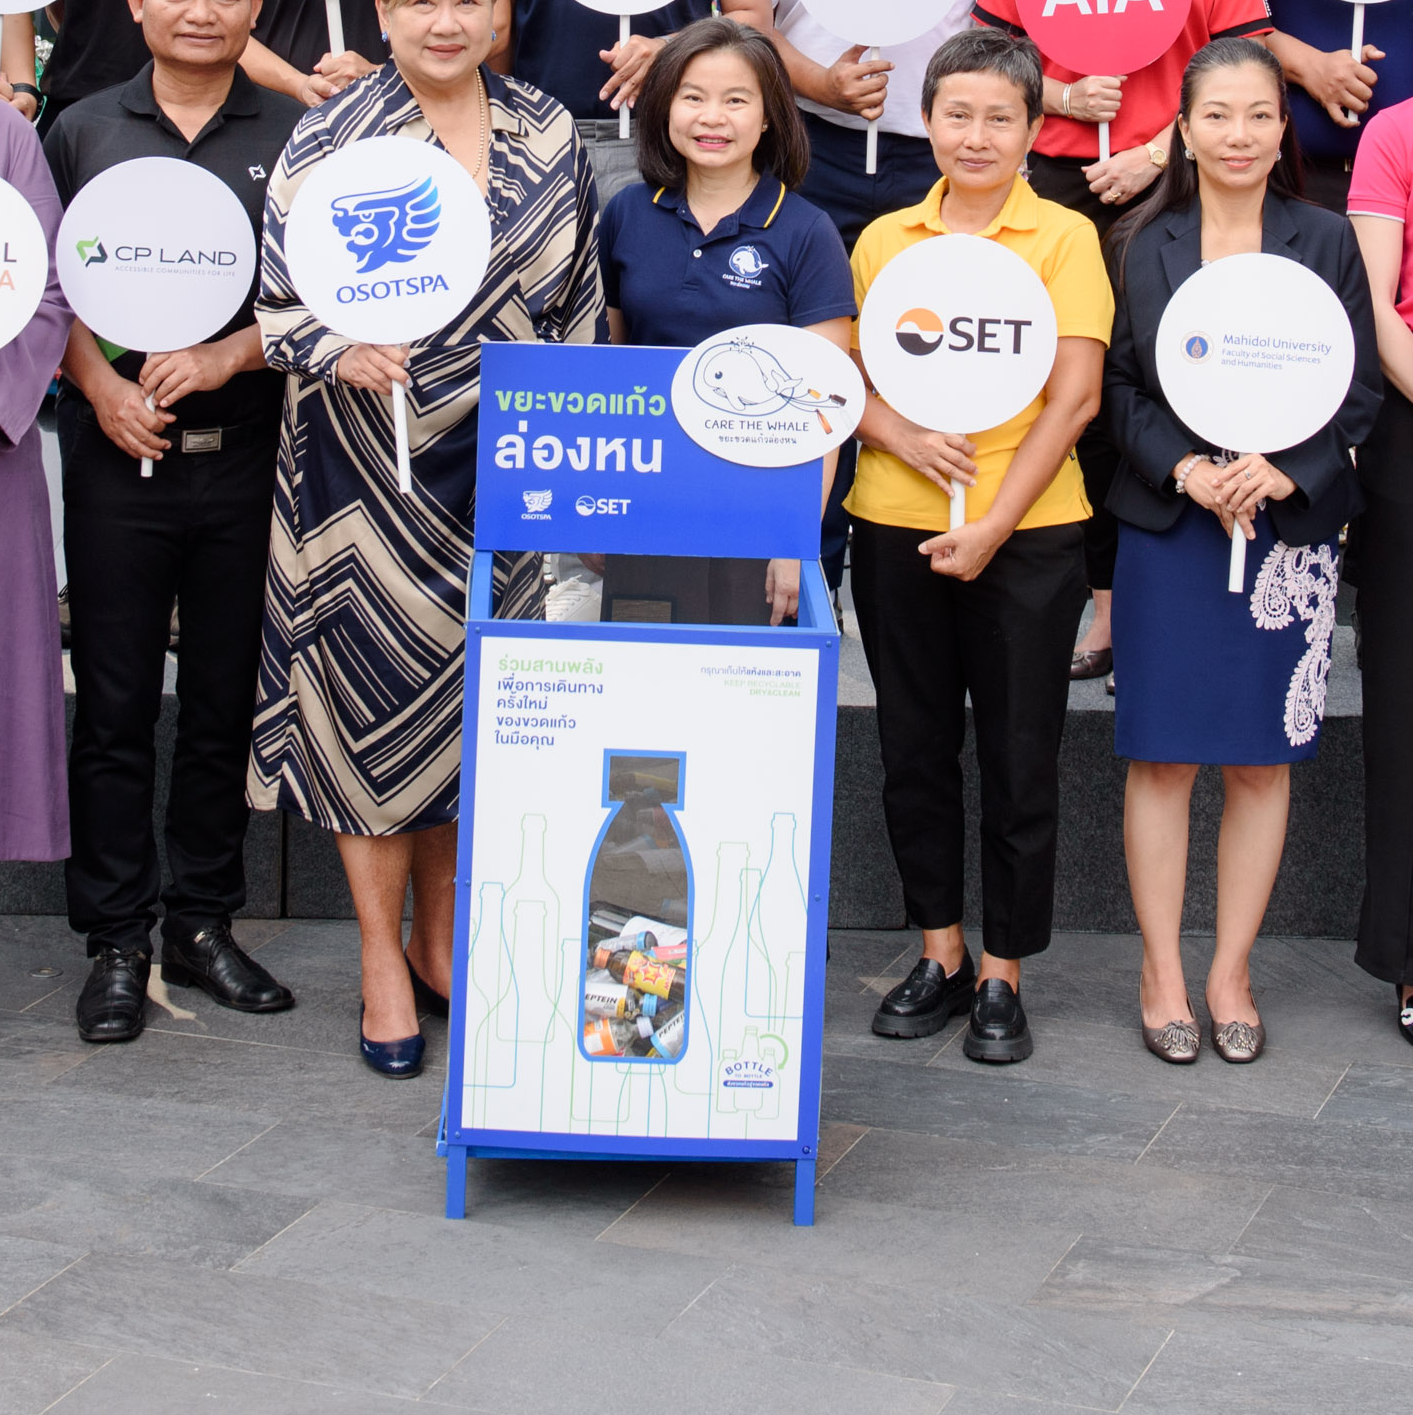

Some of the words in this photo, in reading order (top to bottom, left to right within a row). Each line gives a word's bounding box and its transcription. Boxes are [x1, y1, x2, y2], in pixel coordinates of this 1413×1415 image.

[114, 246, 153, 261] CP
[159, 248, 238, 266] LAND
[115, 266, 154, 274] ACCESSIBLE
[157, 267, 205, 275] COMMUNITIES
[336, 273, 450, 304] OSOTSPA
[947, 316, 1033, 355] SET
[1223, 334, 1271, 348] Mahidol
[1272, 338, 1332, 356] University
[1221, 348, 1250, 359] Faculty
[1251, 351, 1261, 359] of
[1261, 351, 1286, 362] Social
[1286, 354, 1322, 365] Sciences
[1237, 359, 1283, 370] Humanities
[494, 385, 667, 416] ขยะขวดแก้ว
[704, 419, 735, 430] CARE
[739, 419, 763, 430] THE
[766, 421, 810, 432] WHALE
[494, 419, 664, 473] ล่องหน
[596, 498, 632, 515] SET
[521, 513, 553, 521] OSOTSPA
[498, 653, 604, 675] ร่วมสานพลัง
[497, 672, 604, 694] เพื่อการเดินทาง
[497, 692, 549, 710] ครั้งใหม่
[496, 714, 577, 729] ของขวดแก้ว
[494, 729, 555, 750] ในมือคุณ
[585, 993, 619, 1004] EPTEIN
[725, 1061, 773, 1077] BOTTLE
